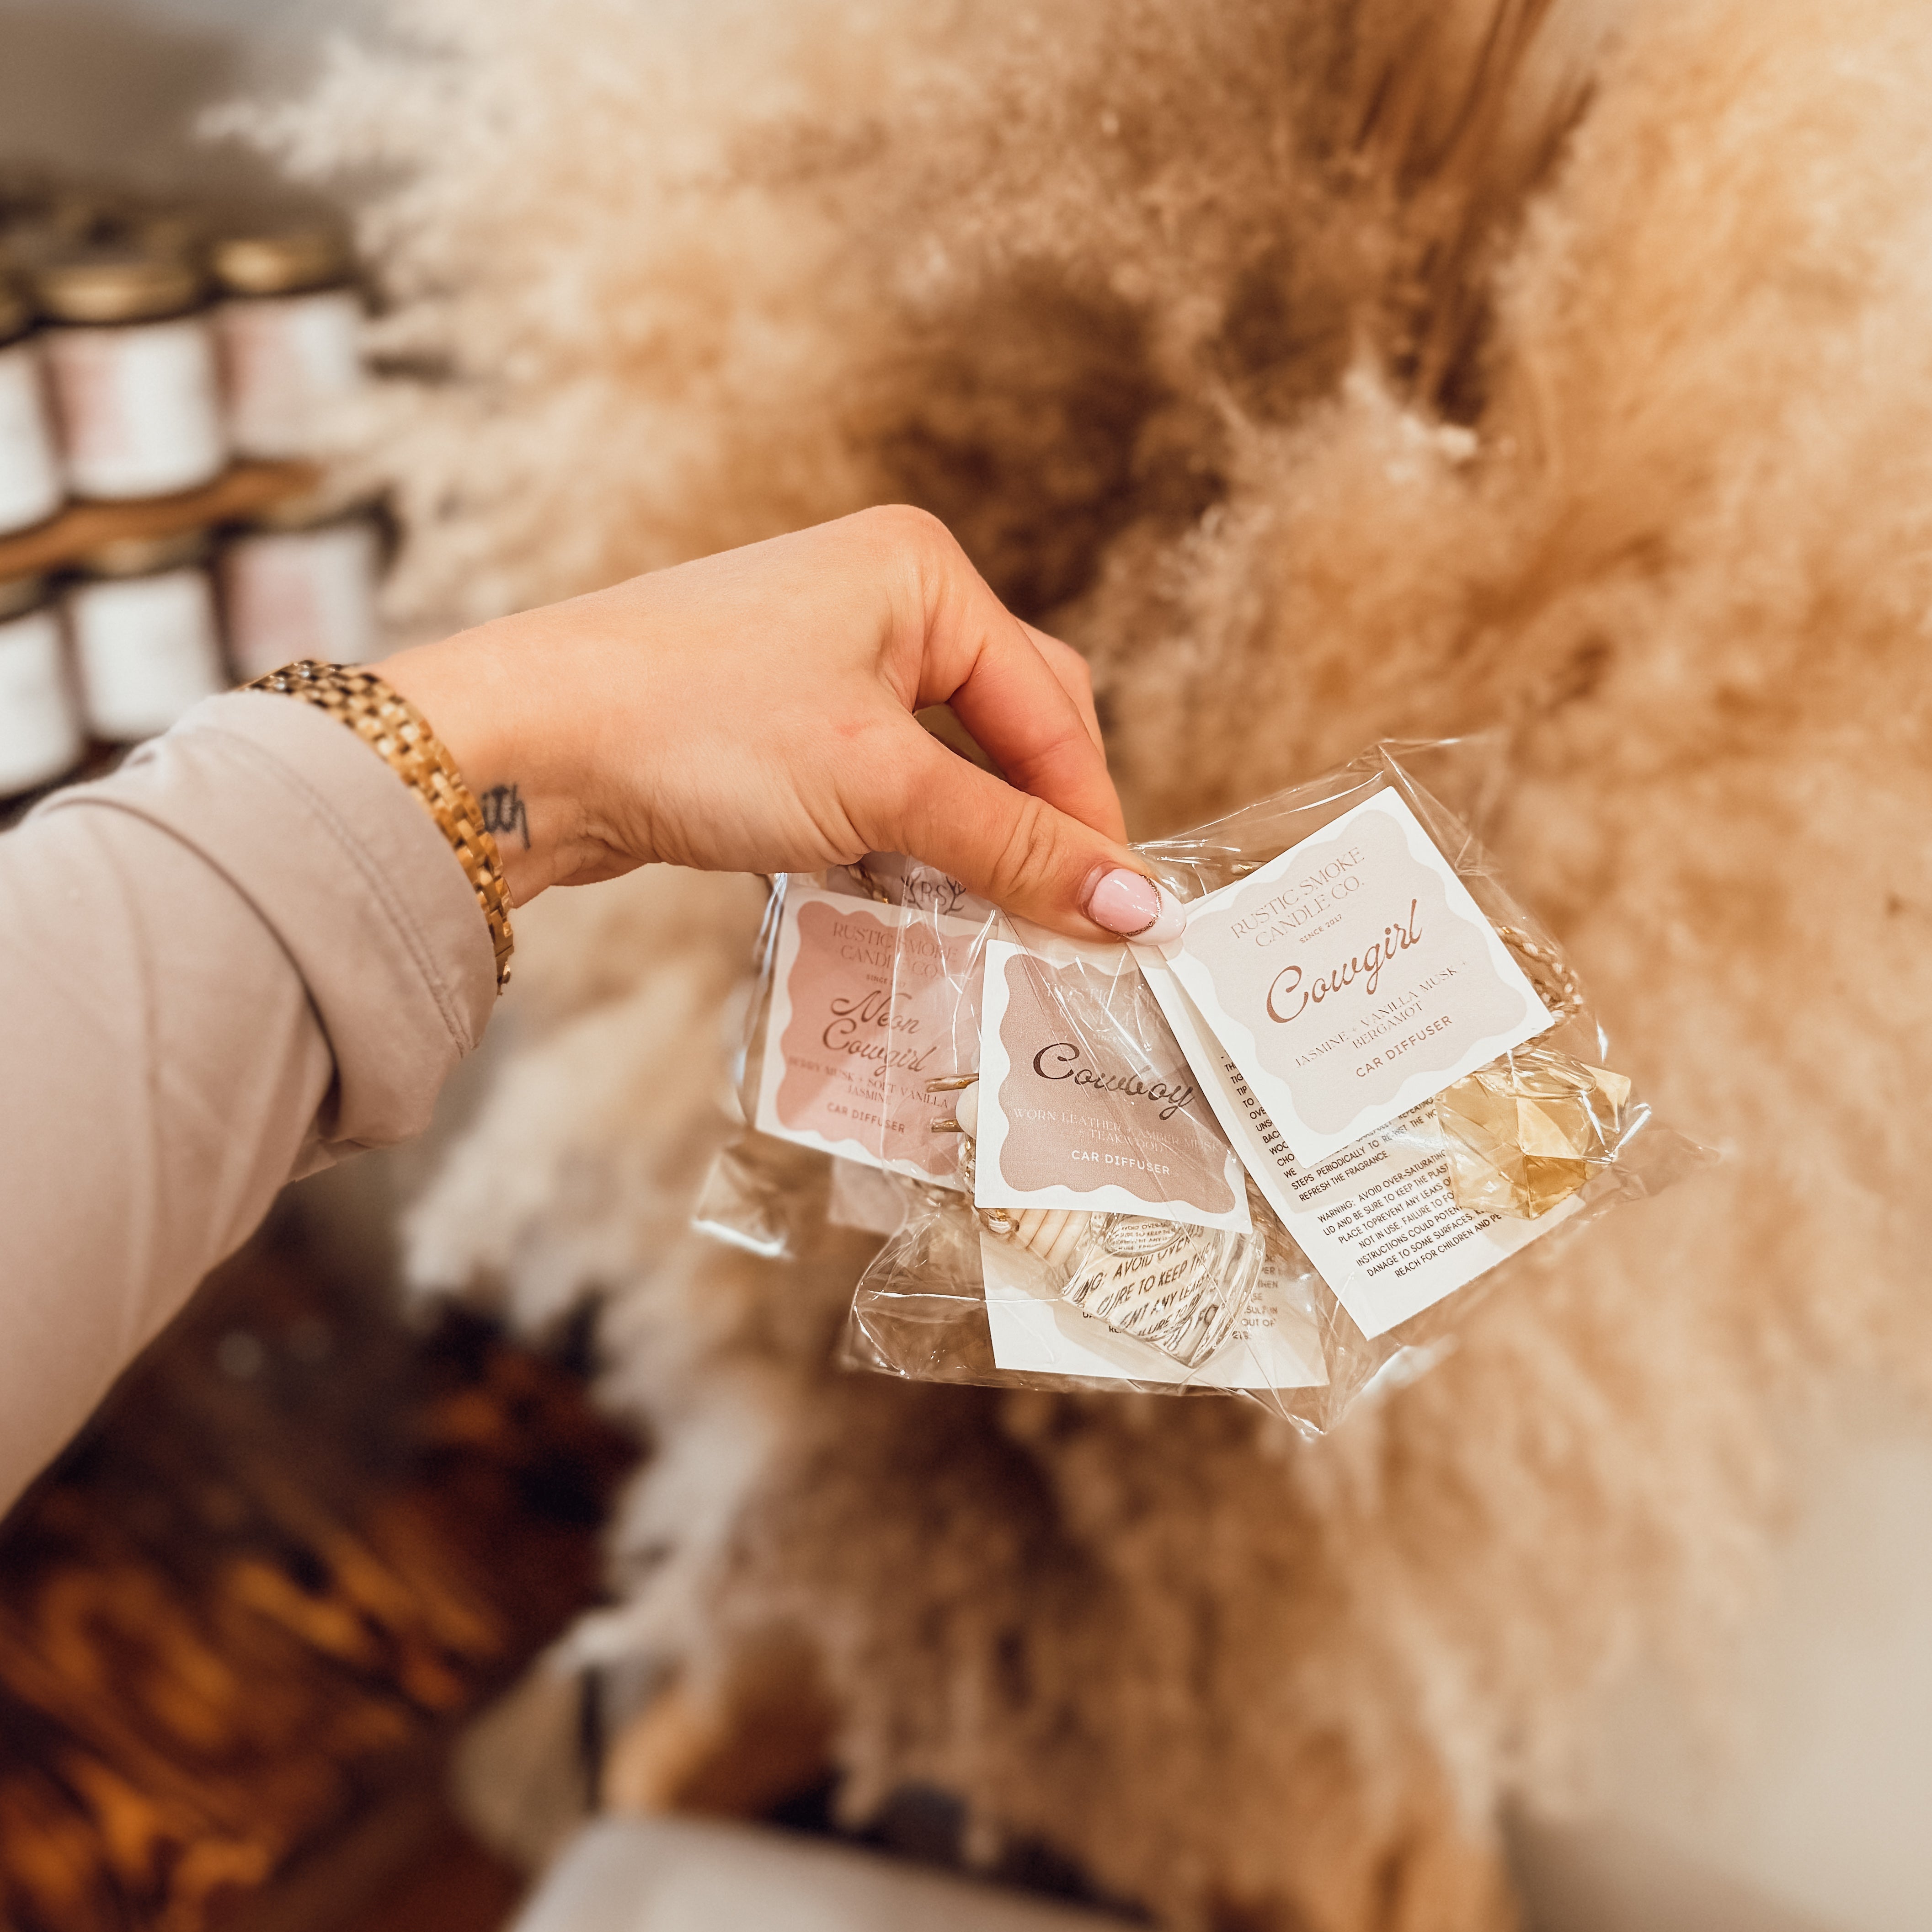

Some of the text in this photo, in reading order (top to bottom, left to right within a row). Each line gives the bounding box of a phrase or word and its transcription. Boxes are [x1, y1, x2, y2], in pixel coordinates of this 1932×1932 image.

[1231, 847, 1365, 938] RUSTIC SMOKE
[1256, 876, 1364, 946] CANDLE CO.
[833, 922, 893, 948] RUSTIC
[1299, 914, 1343, 943] SINCE 2017
[1266, 899, 1423, 1023] Cowgirl
[831, 990, 921, 1034] Neon
[1296, 1031, 1349, 1068] JASMINE
[1360, 991, 1419, 1026] VANILLA
[1419, 967, 1457, 991] MUSK
[1352, 999, 1422, 1049] BERGAMOT
[823, 1018, 937, 1077] Cowgirl
[1224, 1062, 1237, 1072] TH
[1356, 1015, 1452, 1078] CAR DIFFUSER
[901, 1087, 948, 1108] VANILLA
[1033, 1043, 1194, 1121] Cowboy
[1242, 1098, 1254, 1108] TO
[827, 1102, 905, 1133] CAR DIFFUSER
[1014, 1108, 1057, 1121] WORN
[1062, 1112, 1121, 1132] LEATHER
[1072, 1150, 1169, 1175] CAR DIFFUSER
[1292, 1174, 1314, 1190] STEPS
[1316, 1146, 1366, 1177] PERIODICALLY
[1368, 1140, 1379, 1149] TO
[1409, 1116, 1424, 1127] THE
[1299, 1181, 1331, 1202] REFRESH
[1330, 1173, 1346, 1185] THE
[1318, 1200, 1356, 1223] WARNING:
[1358, 1185, 1382, 1202] AVOID
[1323, 1226, 1335, 1235] LID
[1337, 1217, 1352, 1229] AND
[1353, 1210, 1364, 1220] BE
[1364, 1199, 1384, 1214] SURE
[1383, 1194, 1395, 1203] TO
[1395, 1183, 1413, 1197] KEEP
[1413, 1175, 1428, 1186] THE
[1338, 1227, 1363, 1244] PLACE
[1405, 1195, 1420, 1208] ANY
[1420, 1183, 1442, 1199] LEAKS
[1359, 1235, 1375, 1249] NOT
[1375, 1231, 1384, 1239] IN
[1384, 1222, 1403, 1234] USE.
[1402, 1205, 1431, 1225] FAILURE
[1431, 1199, 1442, 1208] TO
[1356, 1234, 1408, 1266] INSTRUCTIONS
[1409, 1219, 1434, 1238] COULD
[1394, 1259, 1421, 1278] REACH
[1420, 1249, 1438, 1262] FOR
[1438, 1229, 1475, 1253] CHILDREN
[1474, 1219, 1490, 1232] AND
[1398, 1249, 1410, 1259] TO
[1410, 1235, 1433, 1253] SOME
[1139, 1275, 1156, 1296] TO
[1158, 1260, 1188, 1287] KEEP
